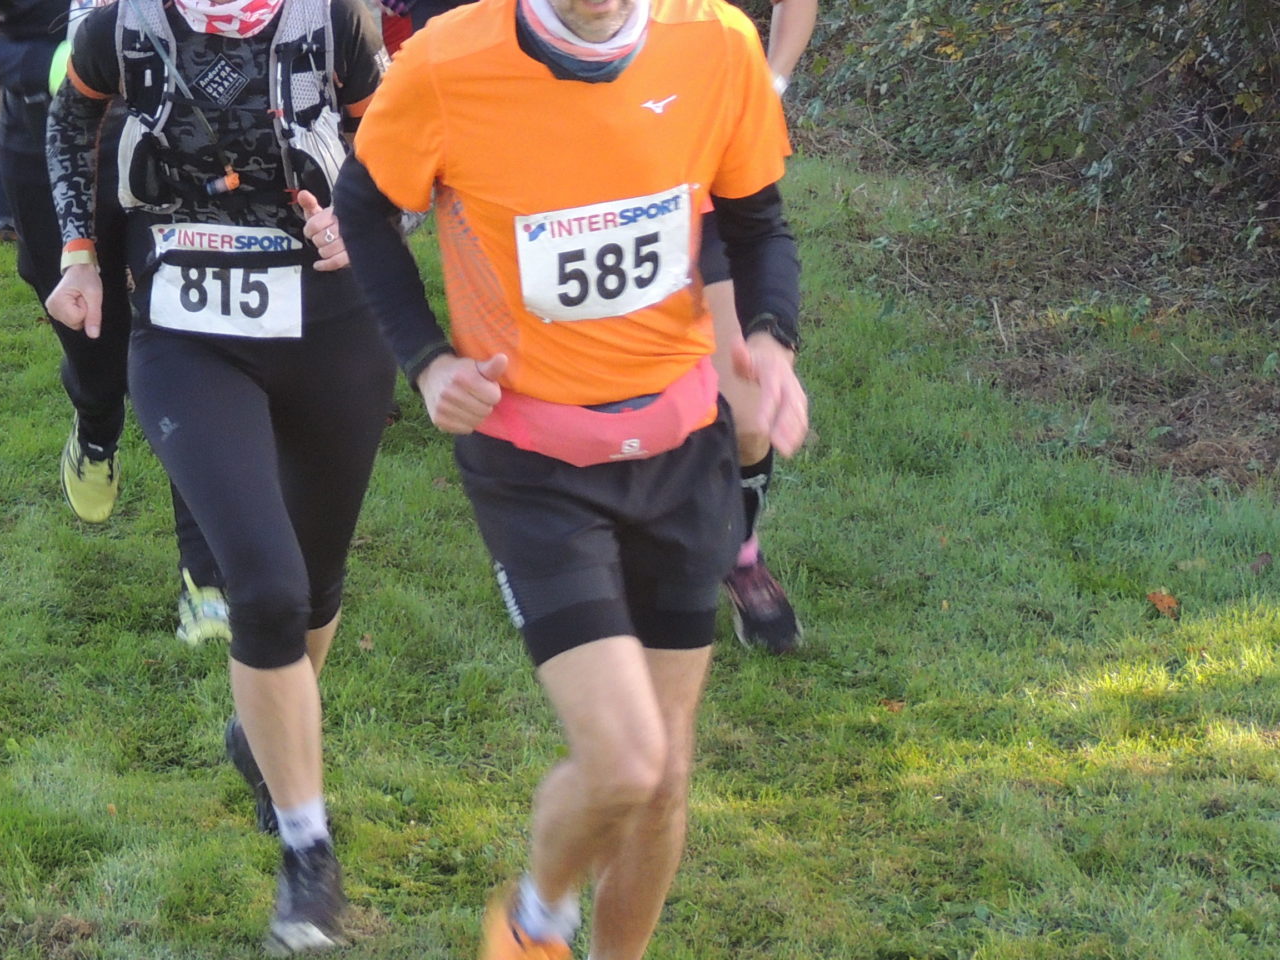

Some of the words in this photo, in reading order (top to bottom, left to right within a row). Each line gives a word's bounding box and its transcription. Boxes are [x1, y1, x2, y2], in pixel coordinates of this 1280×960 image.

[205, 66, 232, 93] ULTRA
[211, 72, 238, 98] TRAIL
[549, 194, 682, 238] INTERSPORT
[177, 229, 292, 252] INTERSPORT
[557, 231, 660, 307] 585
[179, 266, 269, 319] 815
